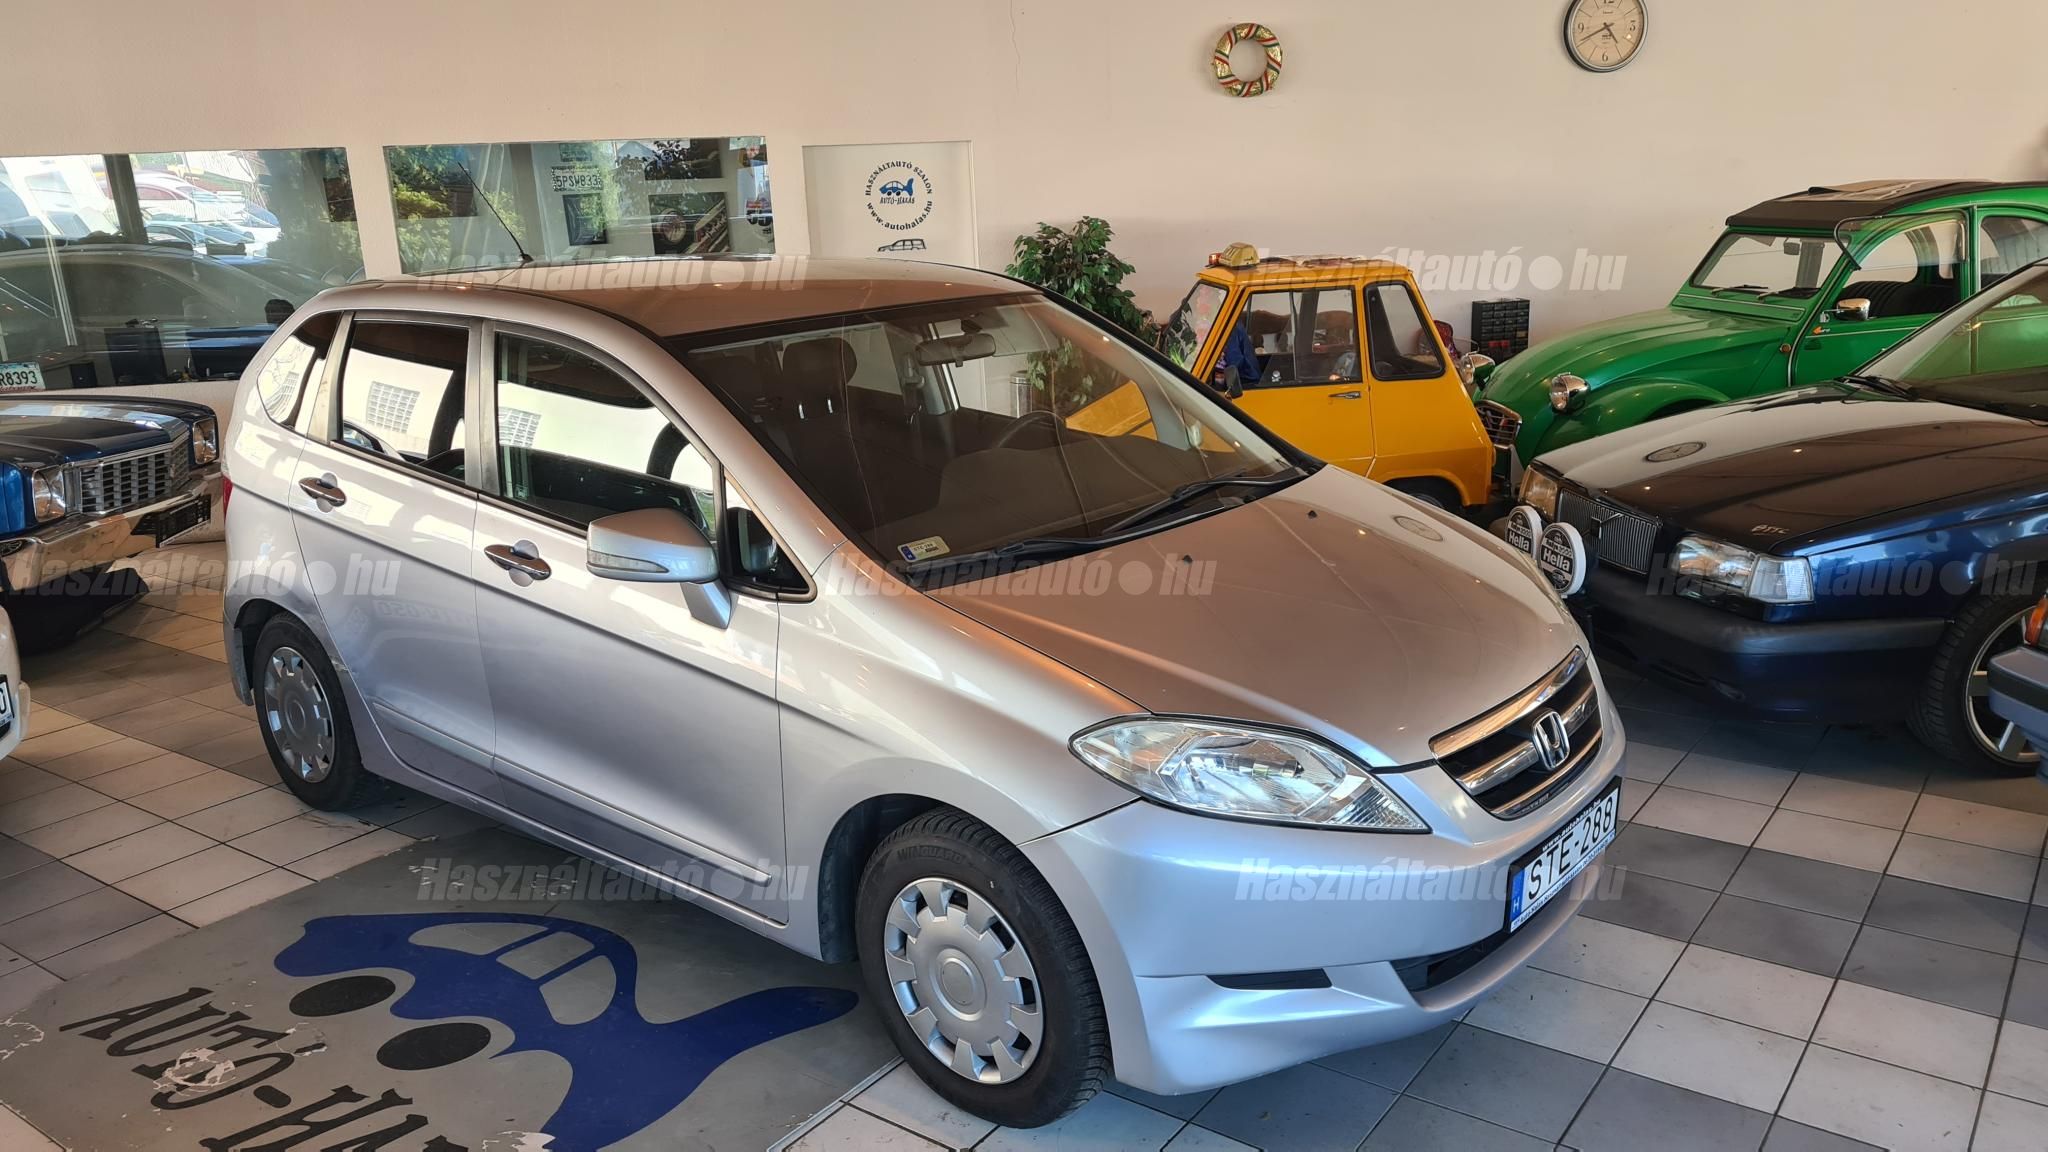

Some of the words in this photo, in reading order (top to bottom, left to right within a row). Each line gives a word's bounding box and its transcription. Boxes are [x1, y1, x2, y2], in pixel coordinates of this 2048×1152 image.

[913, 167, 932, 194] SZALON
[867, 200, 933, 231] www.autohalas.hu
[1508, 530, 1530, 552] Hella
[1543, 548, 1570, 571] Hella
[896, 846, 964, 864] WINGUARD
[1528, 796, 1613, 900] STE-288
